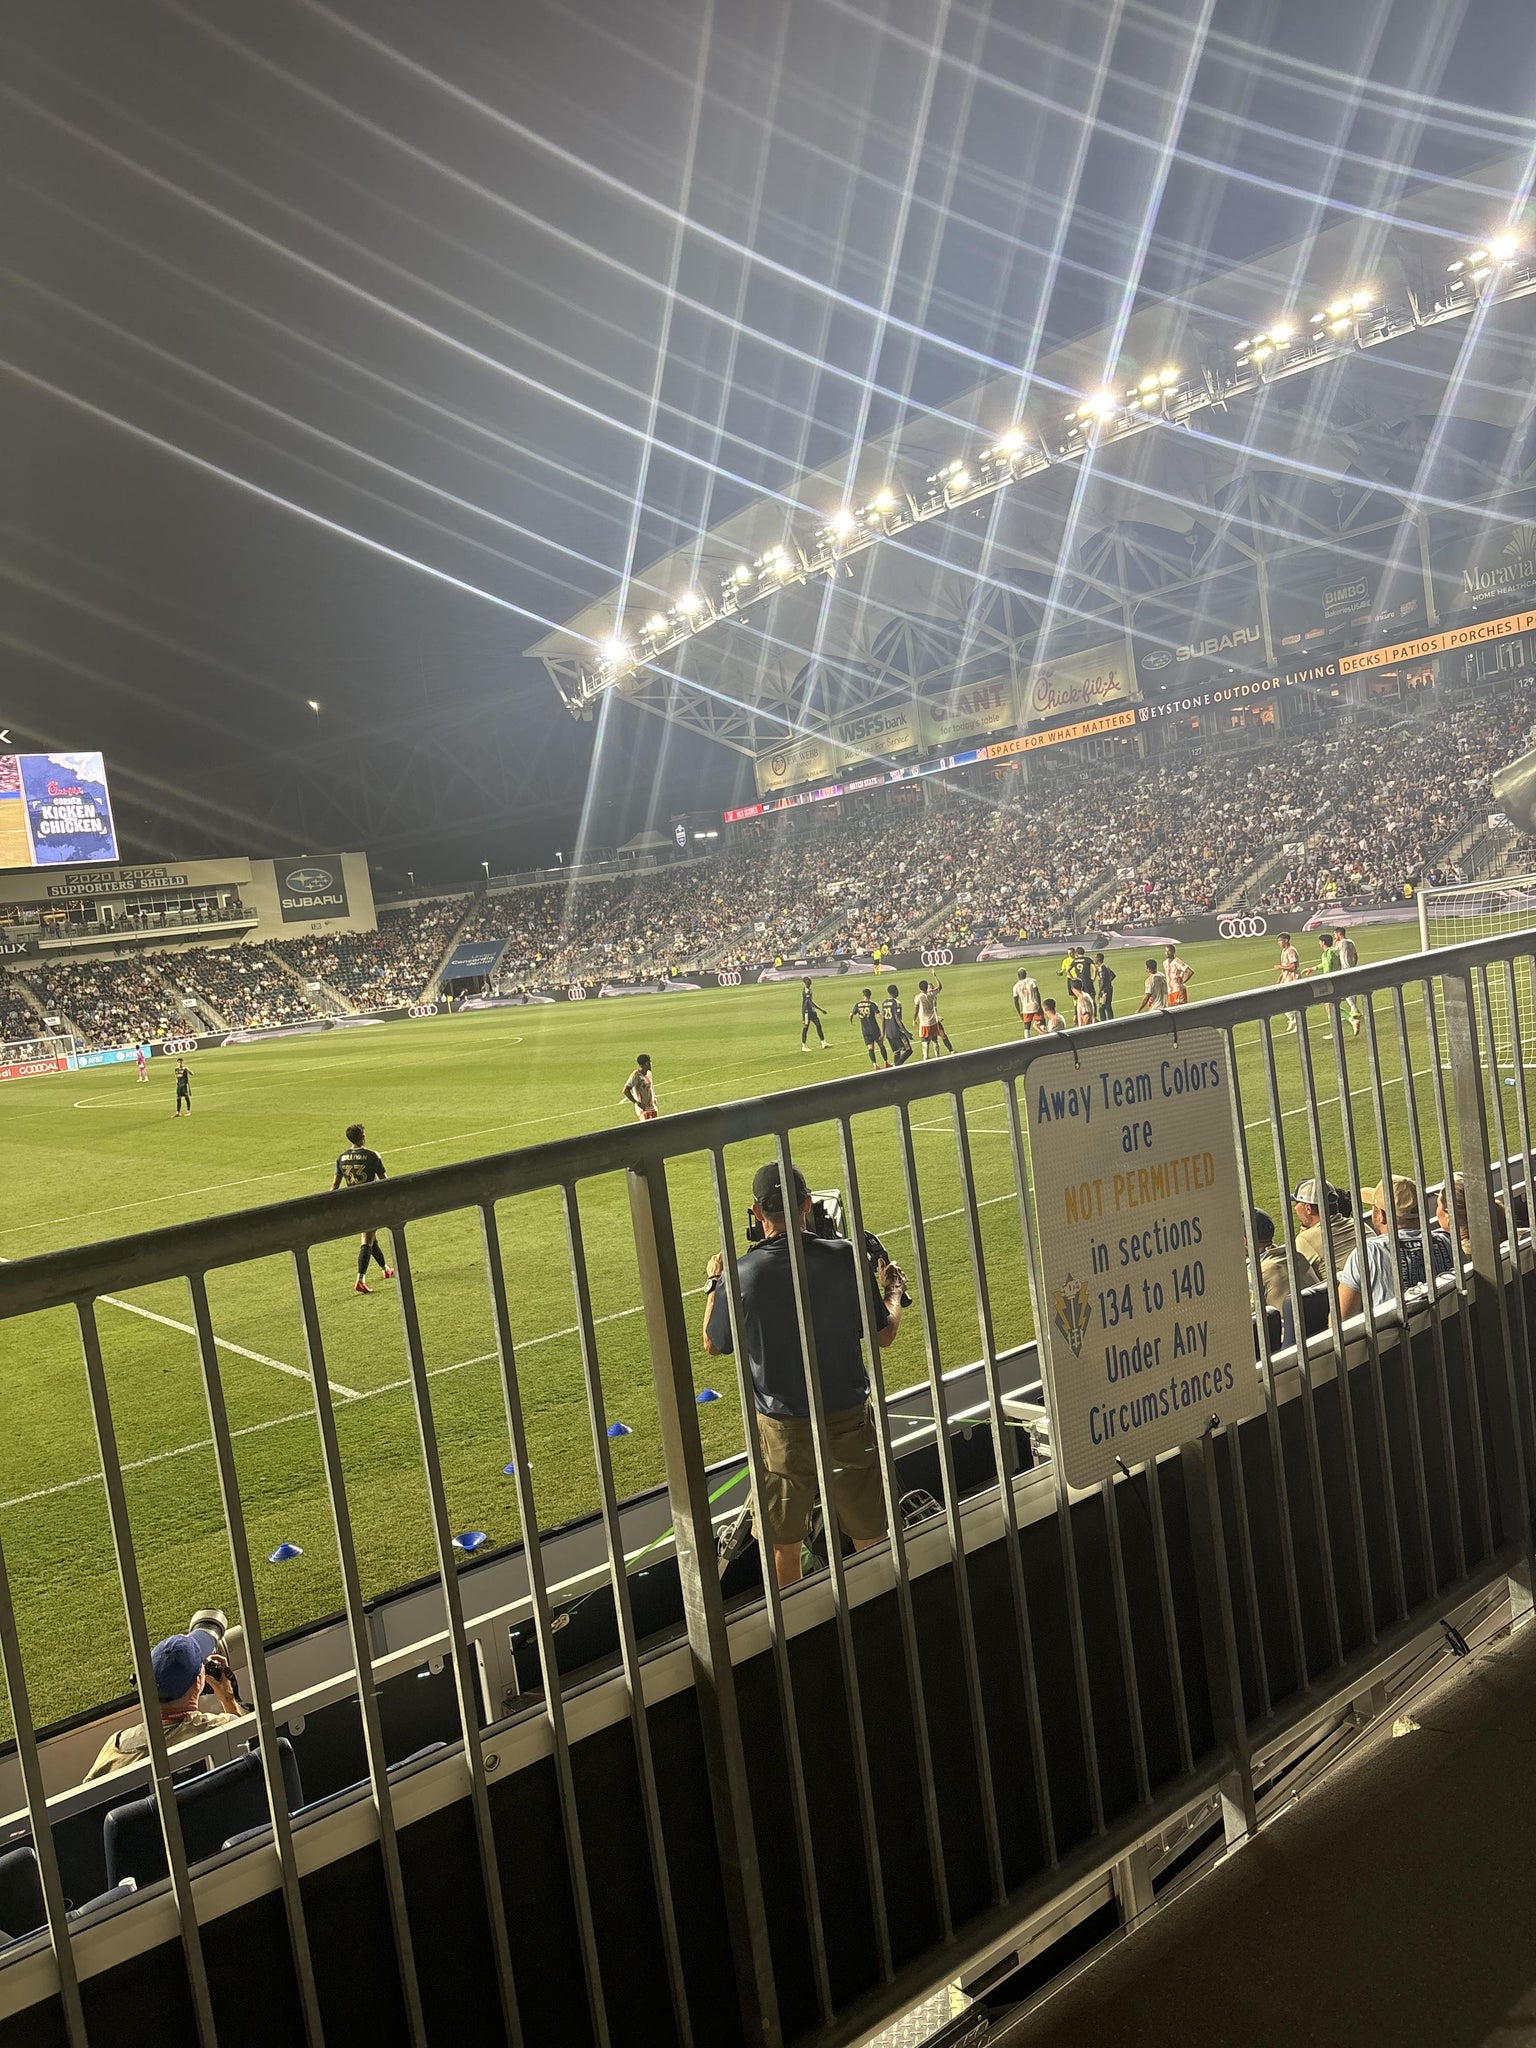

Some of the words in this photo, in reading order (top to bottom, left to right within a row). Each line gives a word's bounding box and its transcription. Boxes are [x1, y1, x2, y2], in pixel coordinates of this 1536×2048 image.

[1324, 583, 1366, 604] BIMBO
[1472, 590, 1496, 602] HOME
[1324, 606, 1351, 619] Bakeries
[1526, 616, 1536, 627] P
[1176, 625, 1260, 662] SUBARU
[1343, 653, 1381, 672] DECKS
[1392, 640, 1438, 660] PATIOS
[1451, 621, 1512, 646] PORCHES
[1032, 669, 1121, 712] Chick-fil-A
[1139, 694, 1211, 722] KEYSTONE
[1213, 677, 1280, 702] OUTDOOR
[1286, 663, 1335, 686] LIVING
[1518, 677, 1535, 688] 129
[931, 684, 1004, 722] GIANT
[839, 714, 884, 743] WSFS
[885, 712, 908, 730] bank
[940, 726, 951, 735] for
[981, 713, 1000, 726] table
[1339, 715, 1353, 726] 128
[991, 742, 1021, 757] SPACE
[1025, 736, 1044, 748] FOR
[1048, 727, 1078, 742] WHAT
[1083, 713, 1132, 734] MATTERS
[799, 748, 819, 761] WEBB
[41, 804, 96, 820] KICKEN
[40, 817, 103, 835] CHICKEN
[69, 872, 113, 885] 2020
[123, 868, 164, 880] 2025
[141, 875, 186, 888] SHIELD
[282, 894, 344, 909] SUBARU
[1076, 963, 1084, 974] 9
[858, 1006, 871, 1020] 39
[1037, 1084, 1092, 1124] Away
[1099, 1072, 1153, 1110] Team
[1160, 1058, 1220, 1098] Colors
[1121, 1120, 1153, 1153] are
[341, 1164, 368, 1185] 33
[1064, 1178, 1103, 1225] NOT
[1112, 1151, 1216, 1212] PERMITTED
[1090, 1238, 1110, 1275] in
[1118, 1216, 1203, 1267] sections
[1098, 1283, 1133, 1329] 134
[1142, 1278, 1164, 1314] to
[1171, 1260, 1205, 1304] 140
[1104, 1336, 1161, 1384] Under
[1173, 1320, 1208, 1358] Any
[1089, 1362, 1234, 1446] Circumstances
